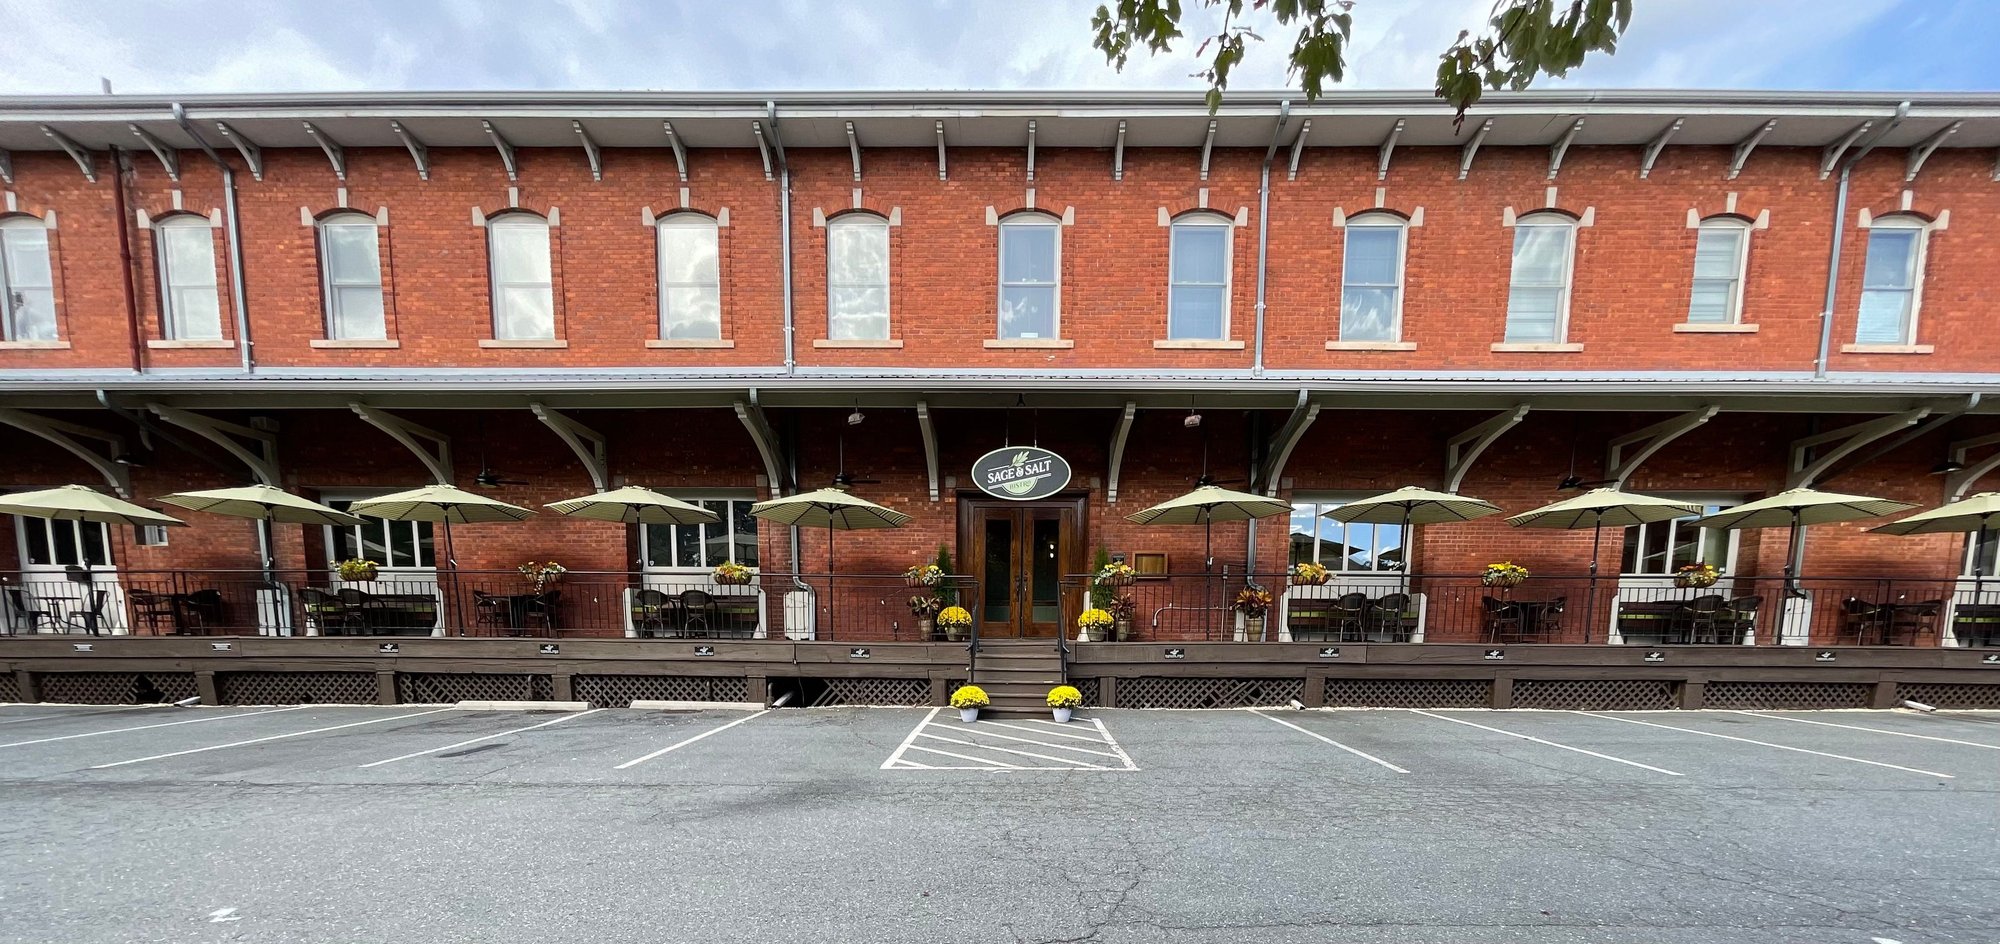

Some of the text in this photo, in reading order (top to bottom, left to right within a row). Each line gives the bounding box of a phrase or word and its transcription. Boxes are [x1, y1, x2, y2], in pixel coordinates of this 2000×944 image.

[988, 460, 1052, 484] SAGE & SALT
